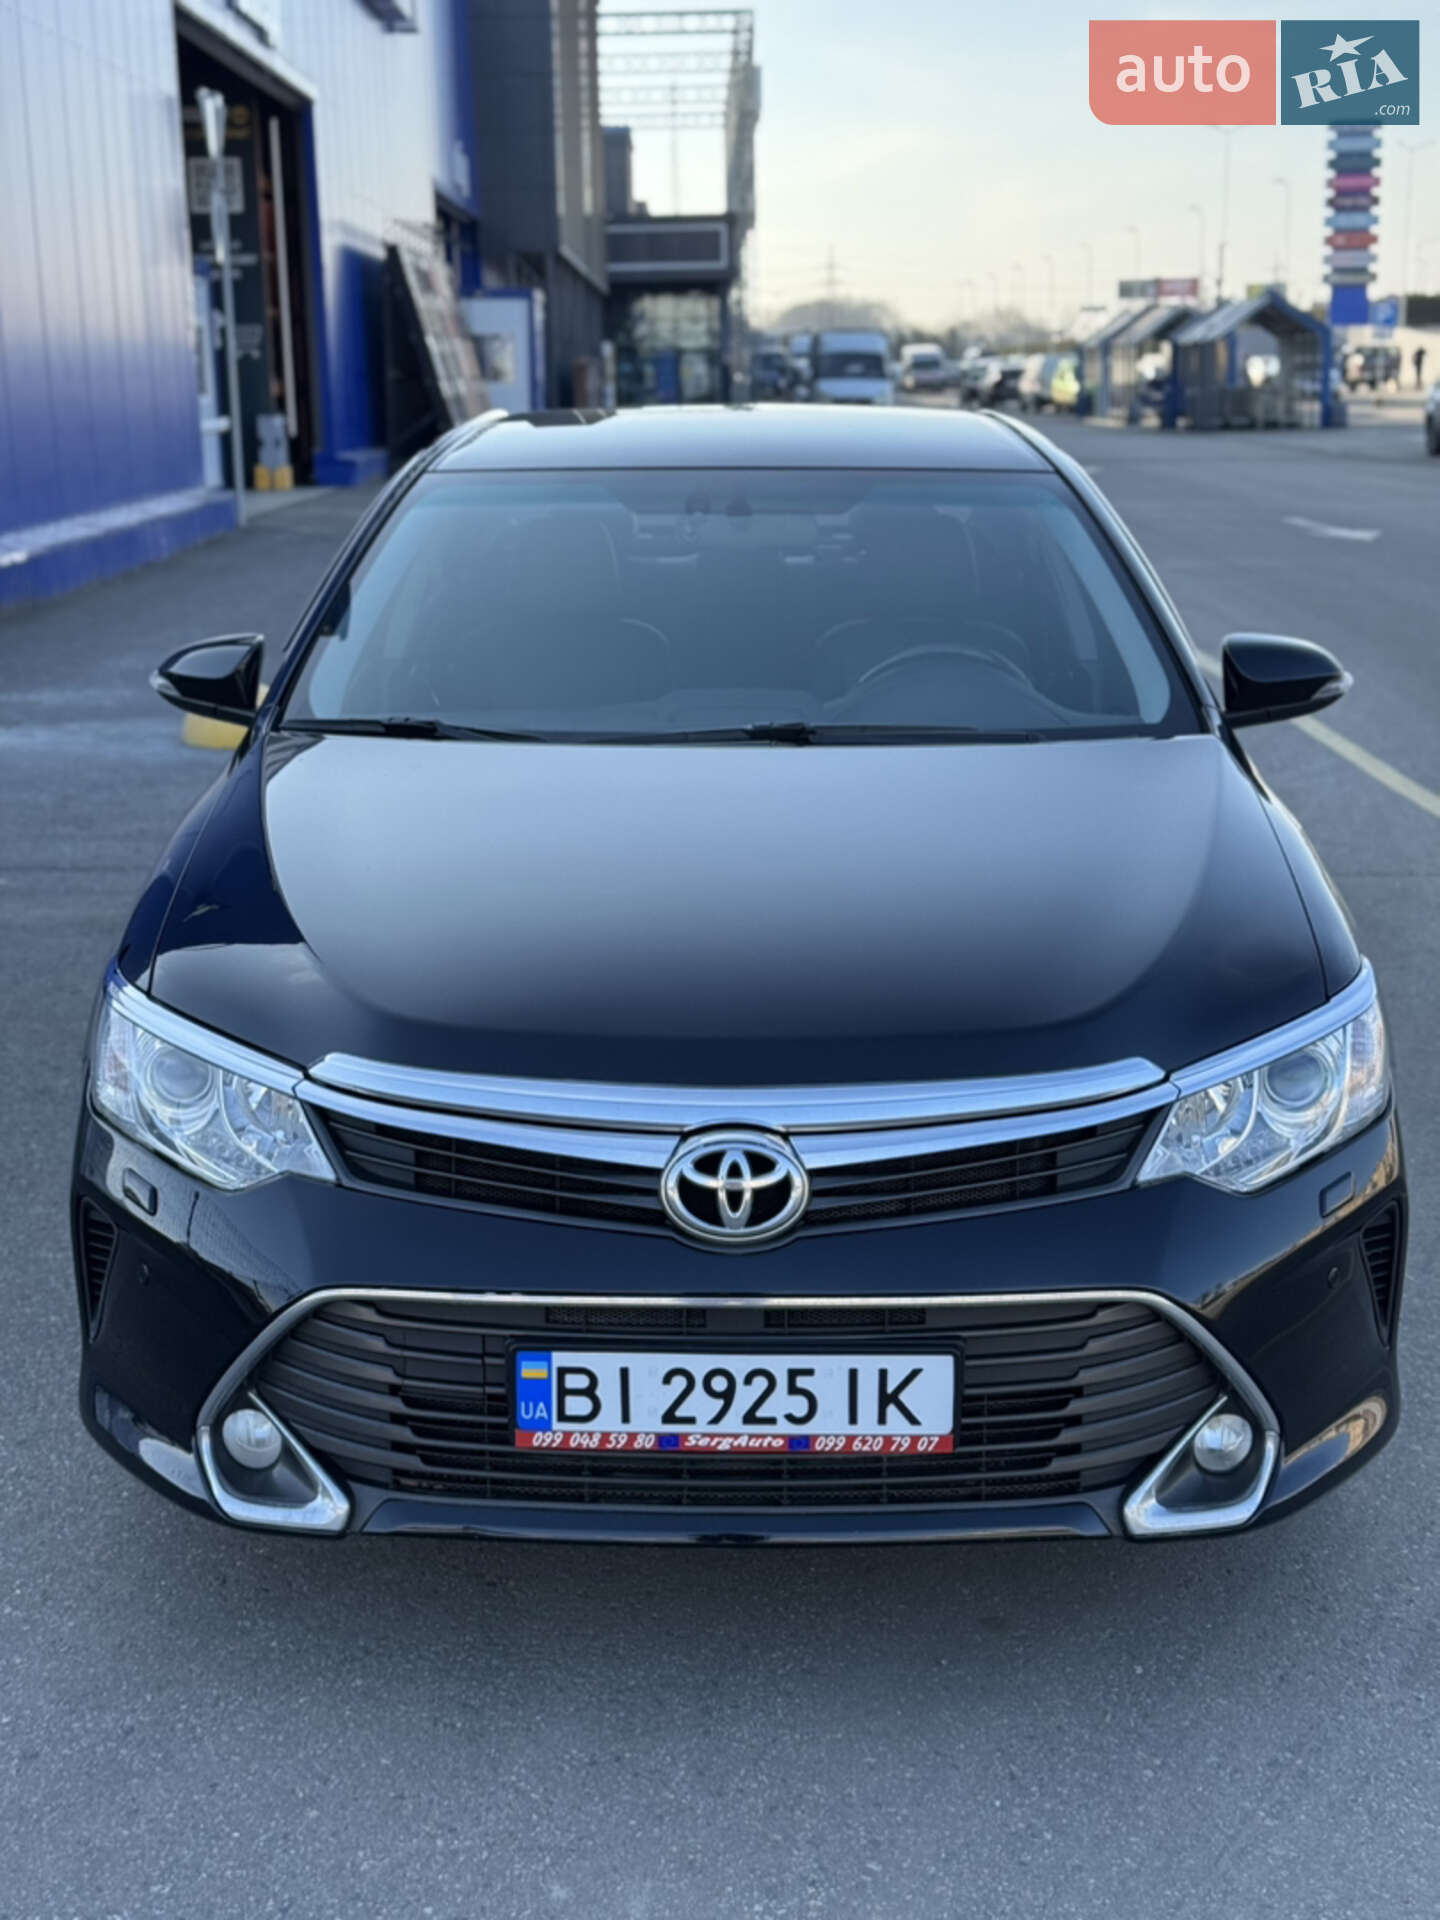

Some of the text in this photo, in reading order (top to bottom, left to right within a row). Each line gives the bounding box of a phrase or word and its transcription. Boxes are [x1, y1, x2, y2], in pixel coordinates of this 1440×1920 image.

[556, 1366, 925, 1427] BI 2925 IK
[520, 1401, 549, 1421] UA
[532, 1431, 940, 1452] 099 048 59 80 SergAuto 099 620 79 07
